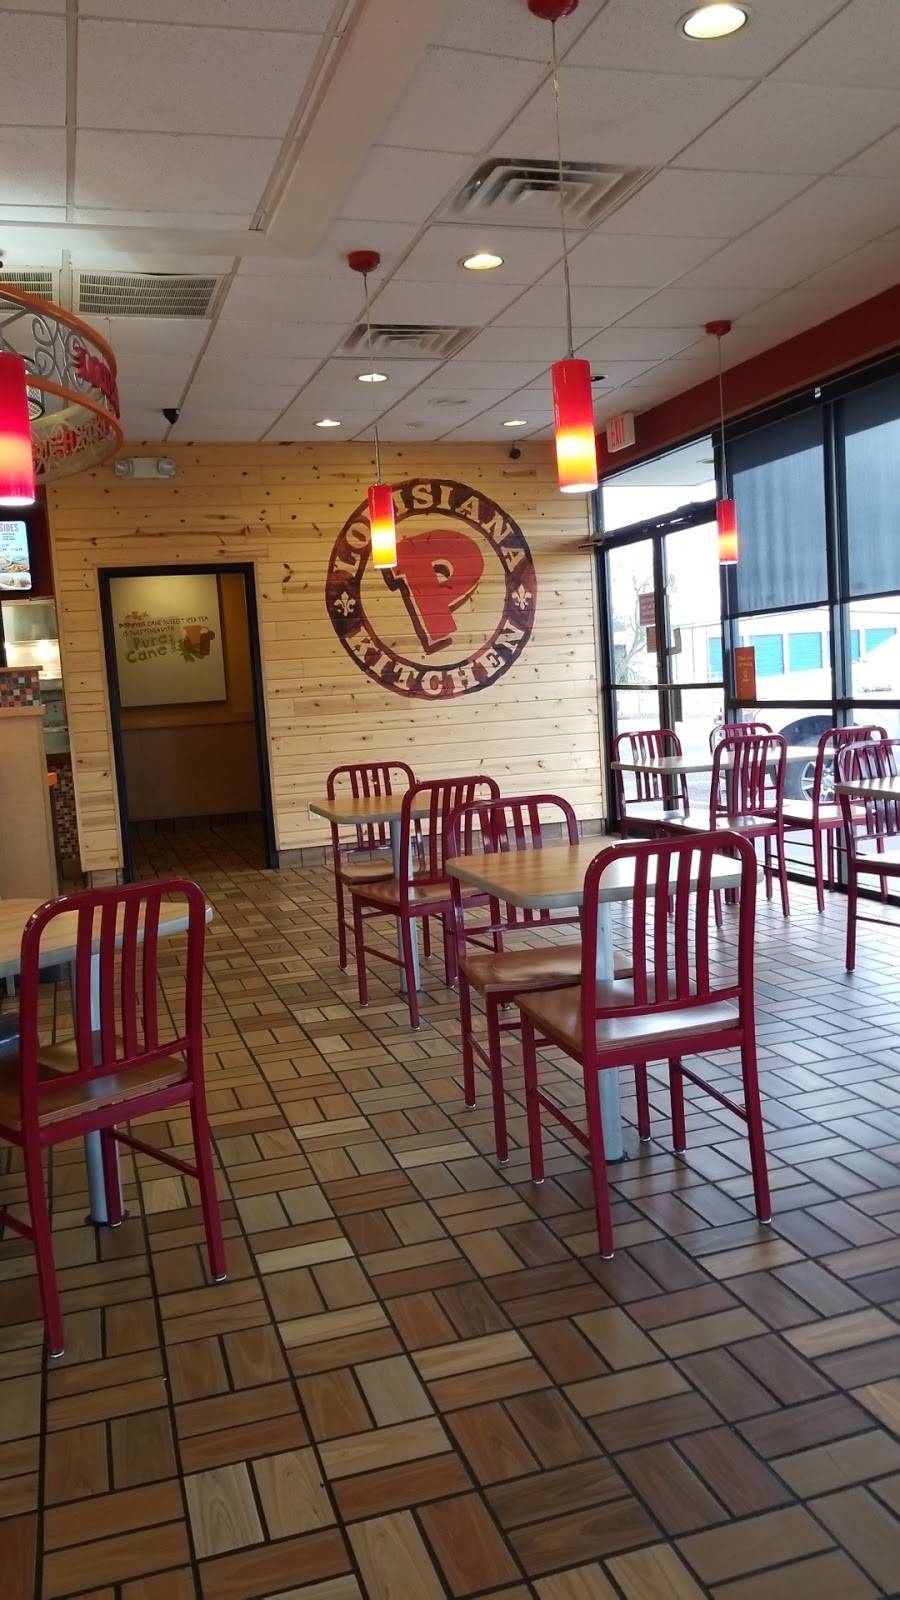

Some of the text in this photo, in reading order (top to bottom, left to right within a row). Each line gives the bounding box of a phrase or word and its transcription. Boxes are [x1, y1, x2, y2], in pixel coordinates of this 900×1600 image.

[609, 416, 625, 448] EXIT
[333, 483, 526, 578] LOISIANA
[126, 646, 168, 663] Cane
[345, 620, 525, 696] KITCHEN
